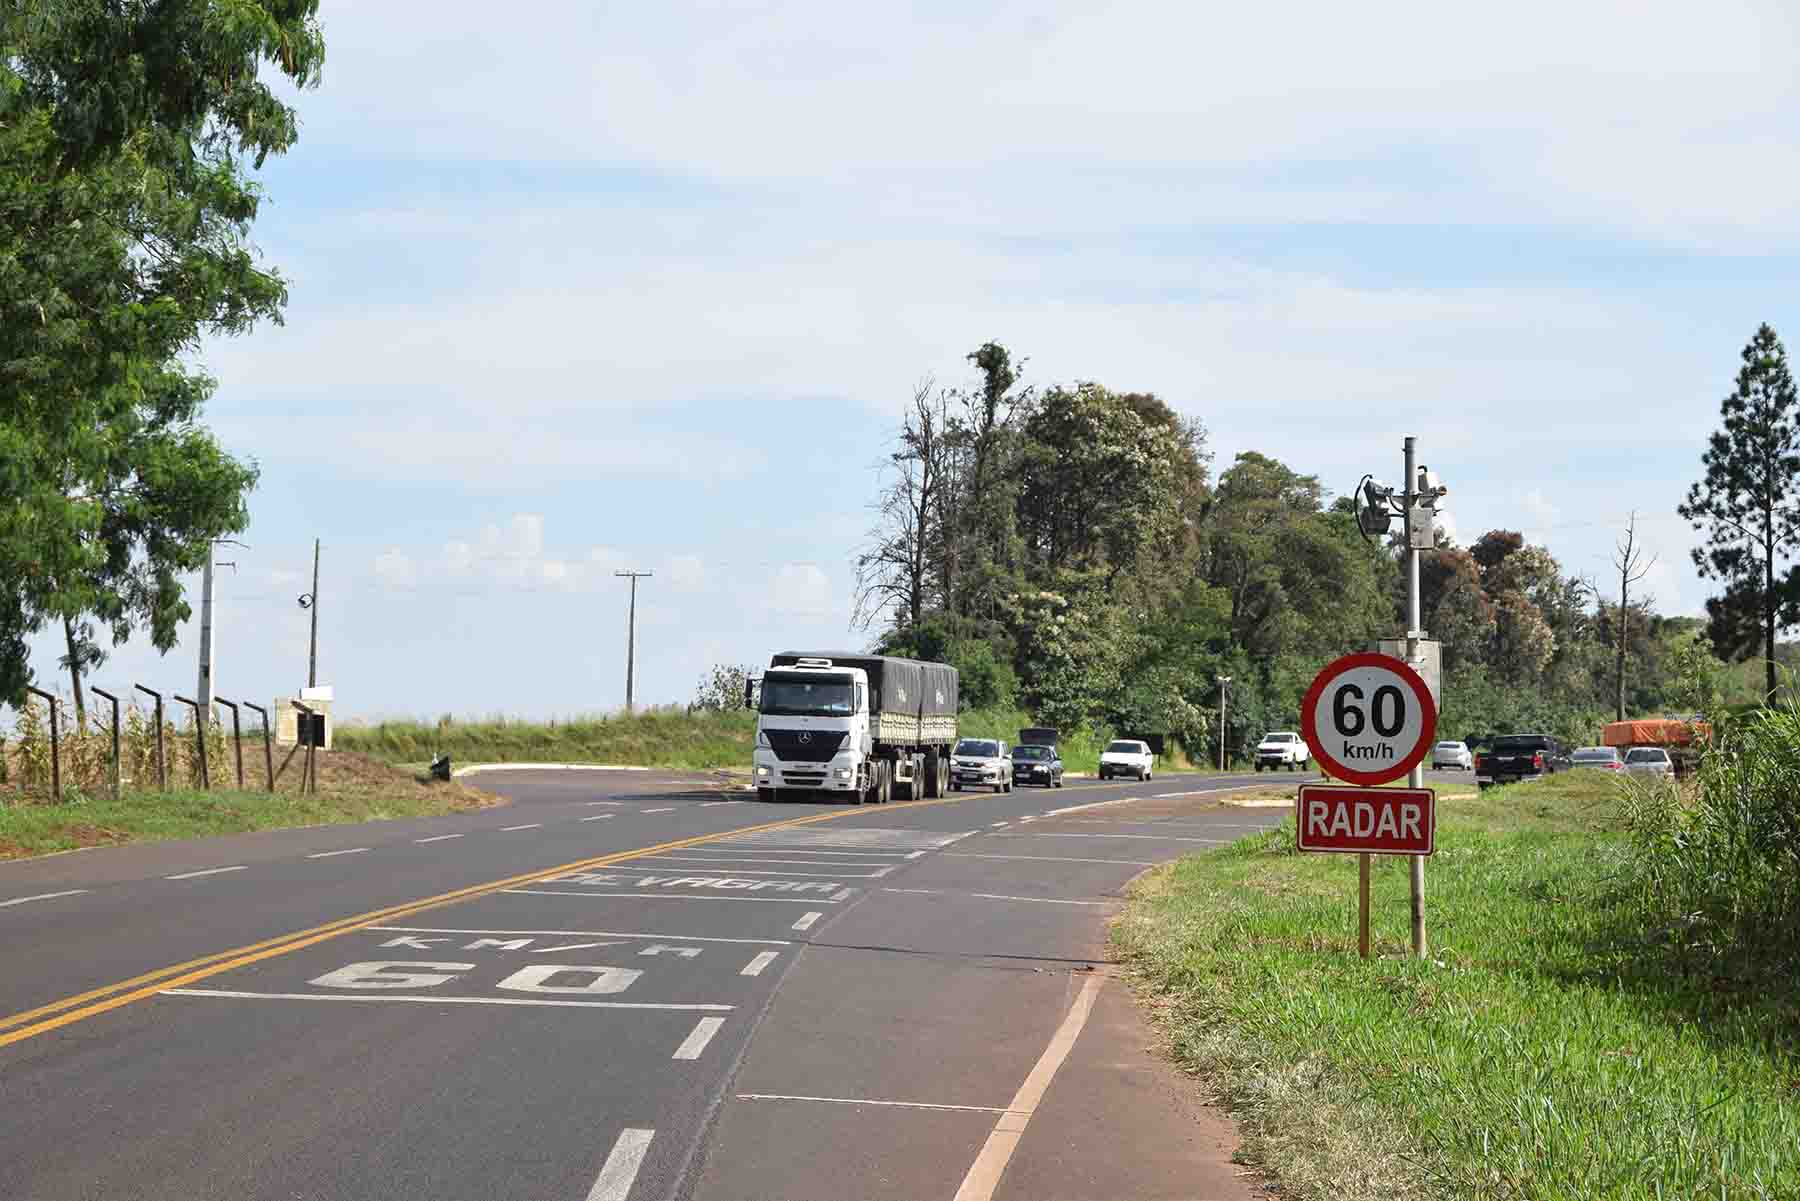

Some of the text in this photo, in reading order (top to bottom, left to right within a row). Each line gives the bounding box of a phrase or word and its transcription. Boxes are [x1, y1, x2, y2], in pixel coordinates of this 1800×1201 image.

[1333, 683, 1405, 738] 60
[1343, 741, 1394, 760] km/h
[1308, 800, 1423, 840] RADAR
[306, 960, 644, 994] 60
